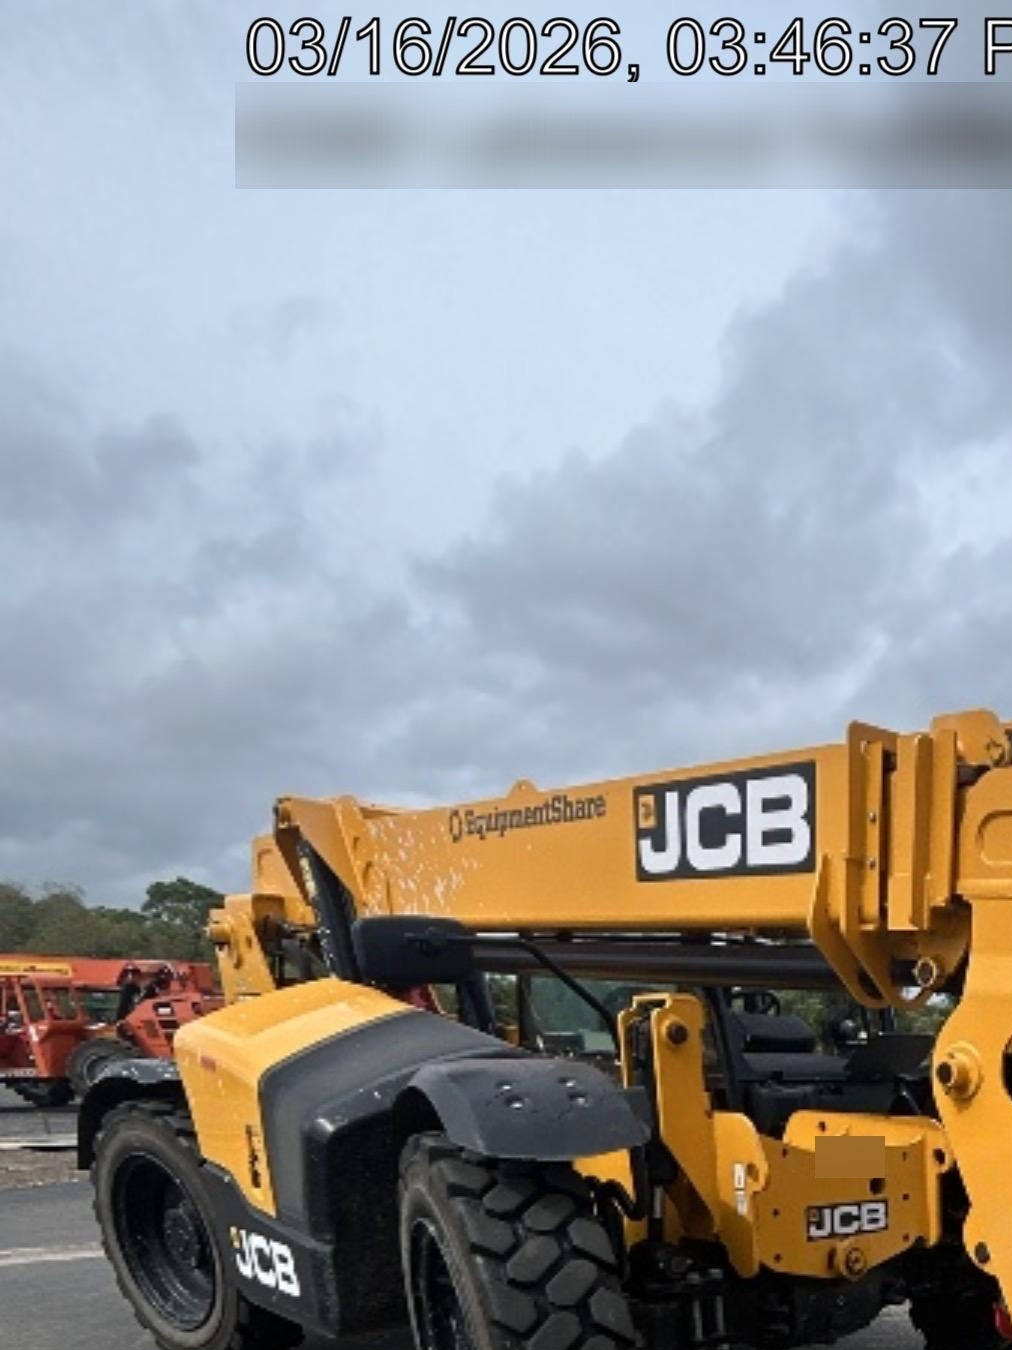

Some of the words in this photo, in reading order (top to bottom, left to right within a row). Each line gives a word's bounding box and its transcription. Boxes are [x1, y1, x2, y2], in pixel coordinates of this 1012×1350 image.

[464, 794, 607, 840] EquipmentShare
[637, 773, 811, 873] JCB
[808, 1202, 886, 1237] JCB
[235, 1229, 301, 1297] JCB
